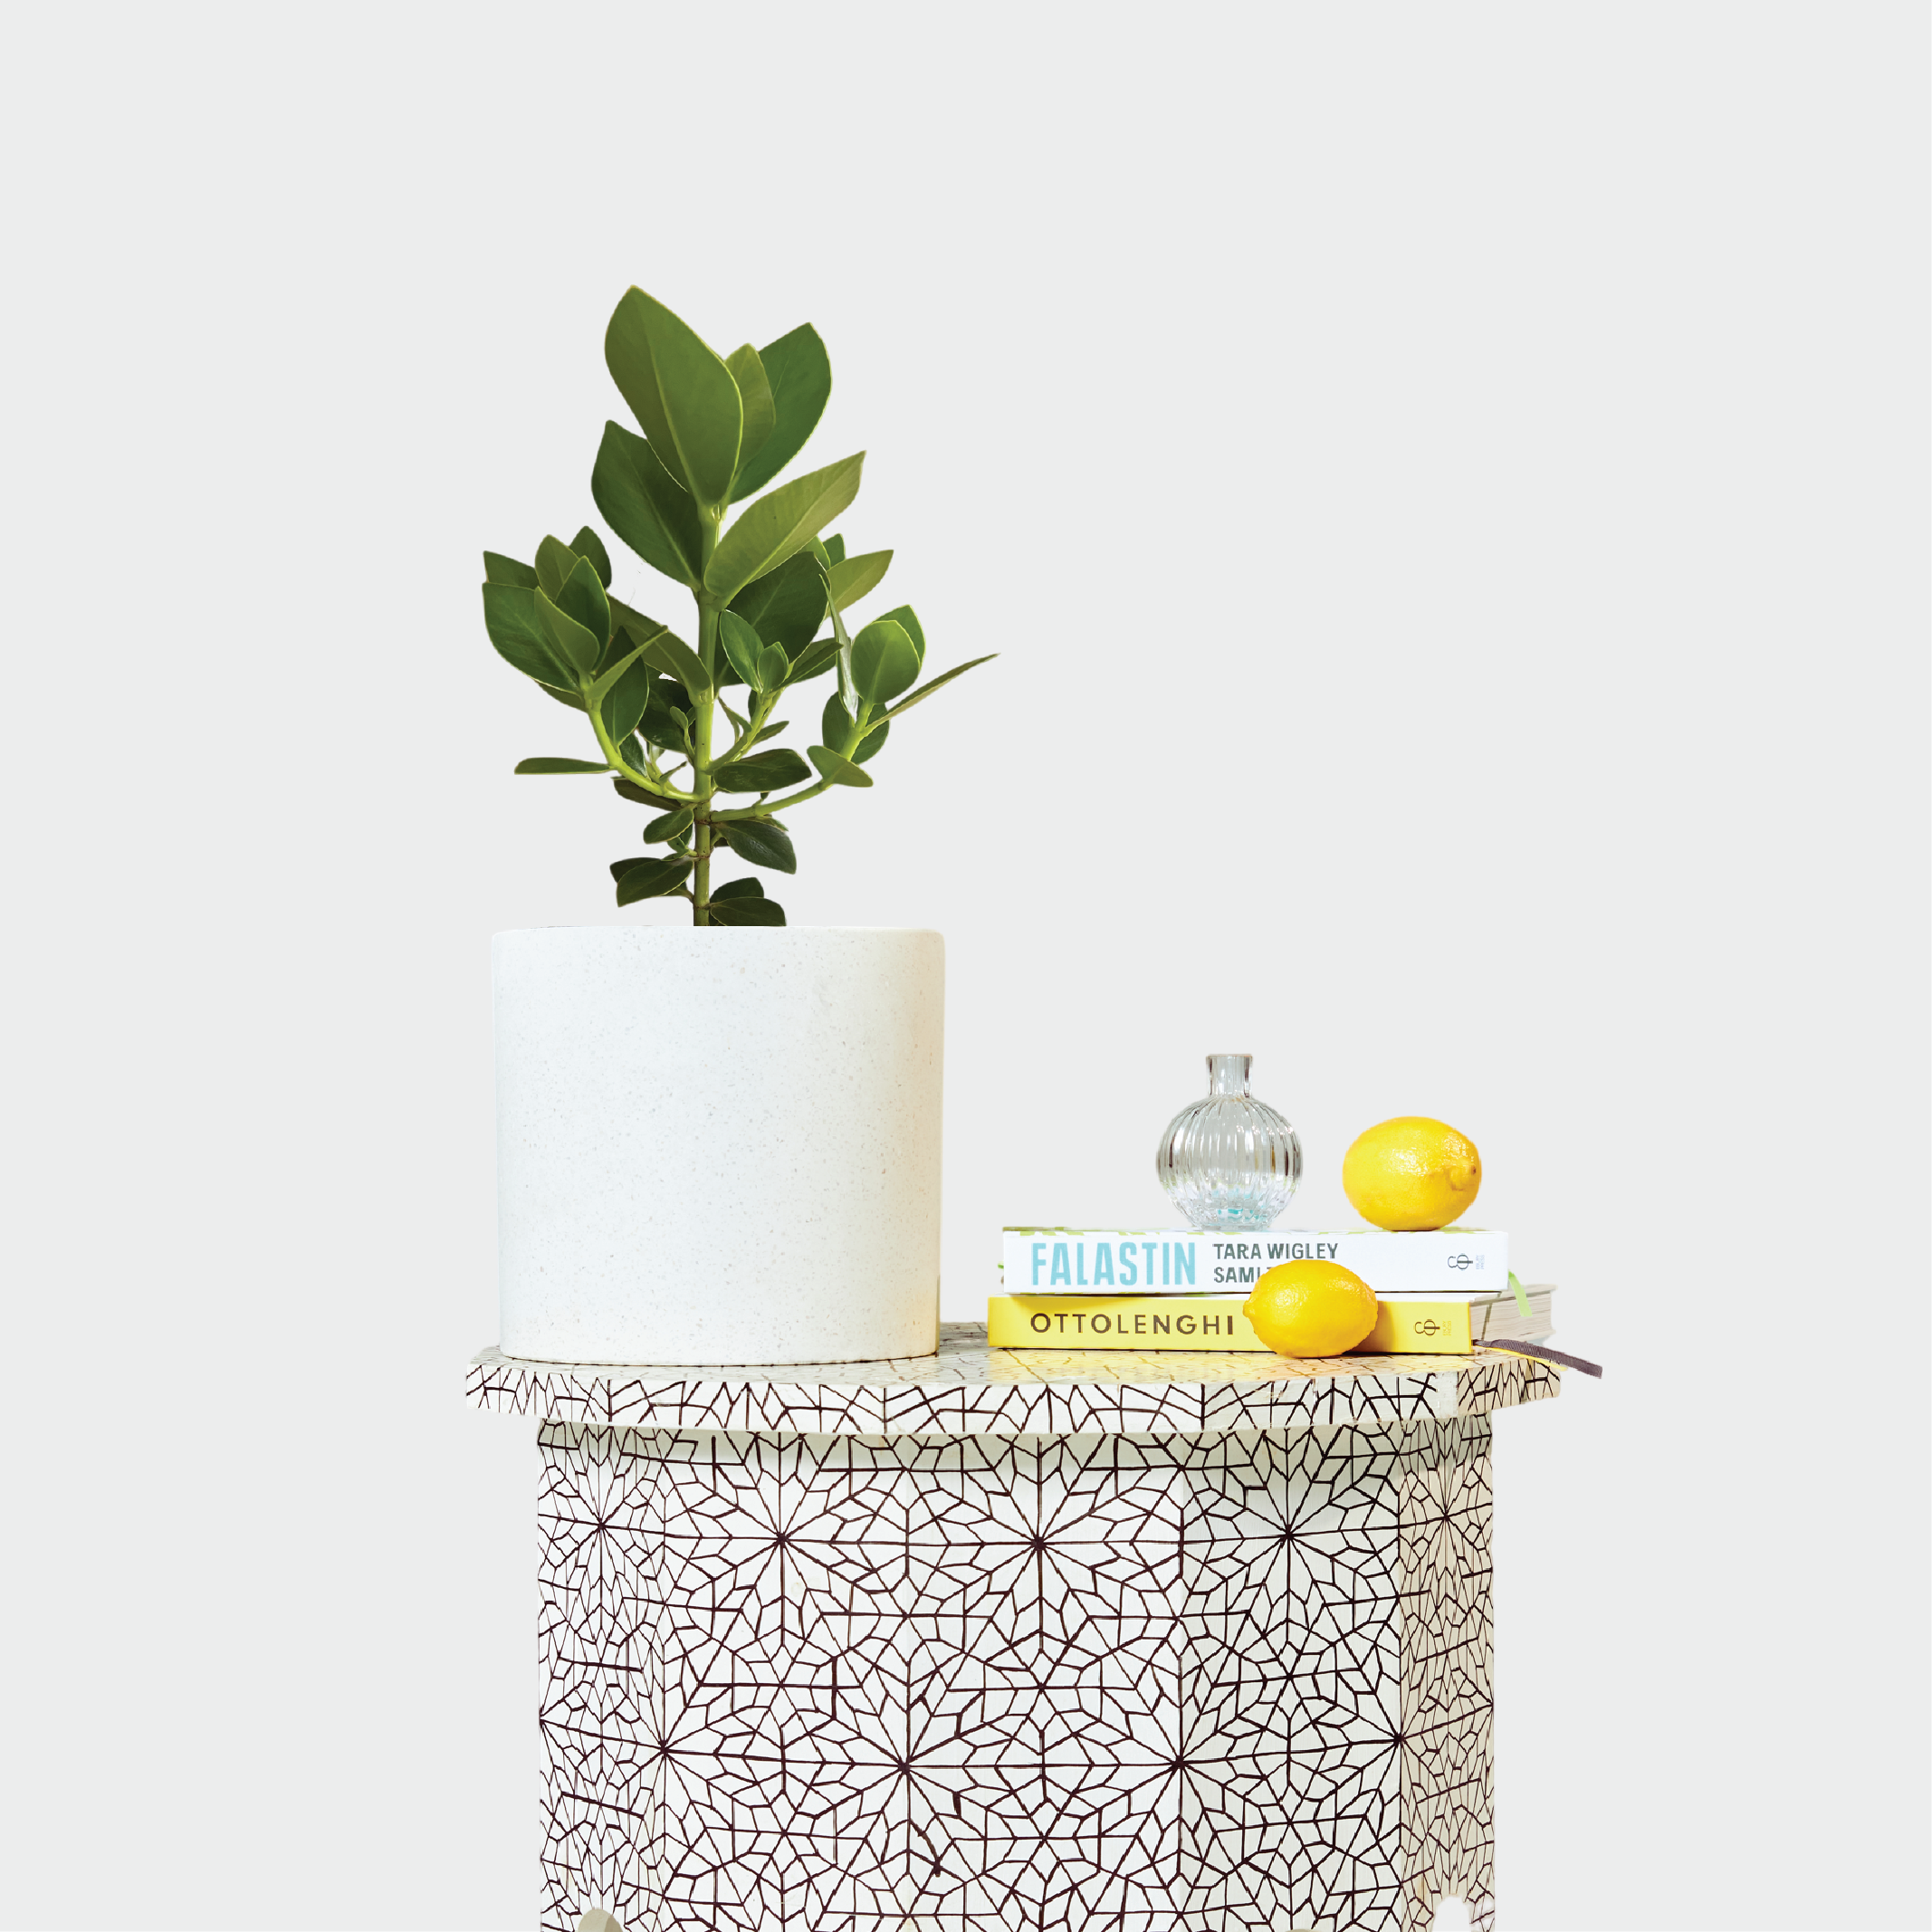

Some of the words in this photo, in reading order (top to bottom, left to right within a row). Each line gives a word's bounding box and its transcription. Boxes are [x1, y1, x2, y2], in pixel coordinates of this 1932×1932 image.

[1213, 1243, 1263, 1260] TARA
[1267, 1243, 1338, 1262] WIGLEY
[1031, 1241, 1196, 1286] FALASTIN
[1213, 1267, 1260, 1284] SAMI
[1030, 1313, 1234, 1335] OTTOLENGHI
